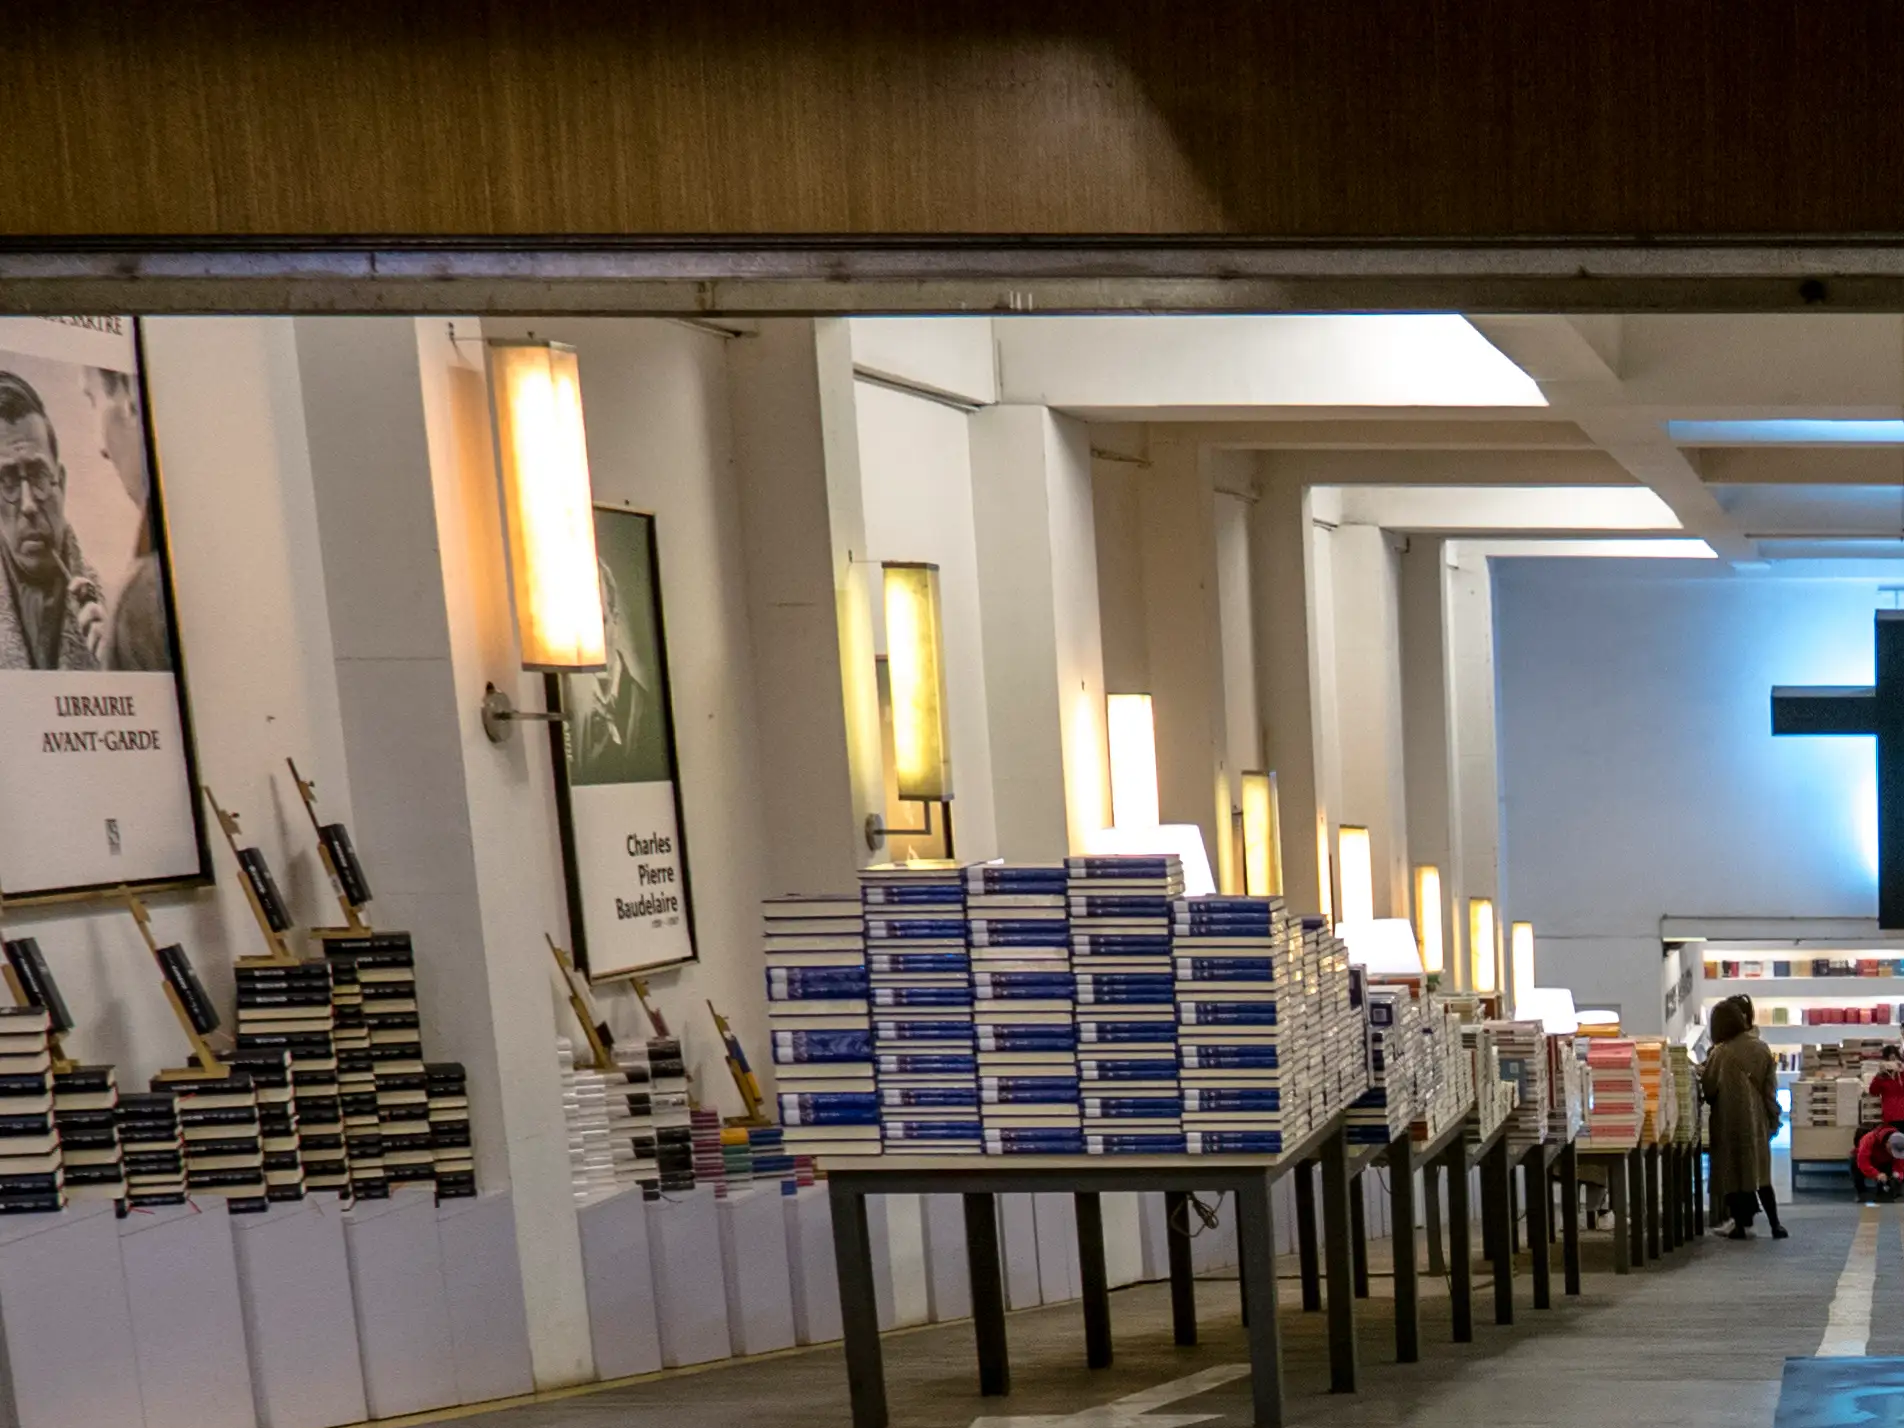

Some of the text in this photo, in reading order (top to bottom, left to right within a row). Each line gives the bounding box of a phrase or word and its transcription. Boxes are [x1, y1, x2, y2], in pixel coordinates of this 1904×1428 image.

[54, 695, 137, 717] LIBRAIRIE
[42, 730, 161, 752] AVANT-GARDE
[626, 831, 672, 857] Charles
[638, 863, 675, 887] Pierre
[615, 892, 678, 920] Baudelaire
